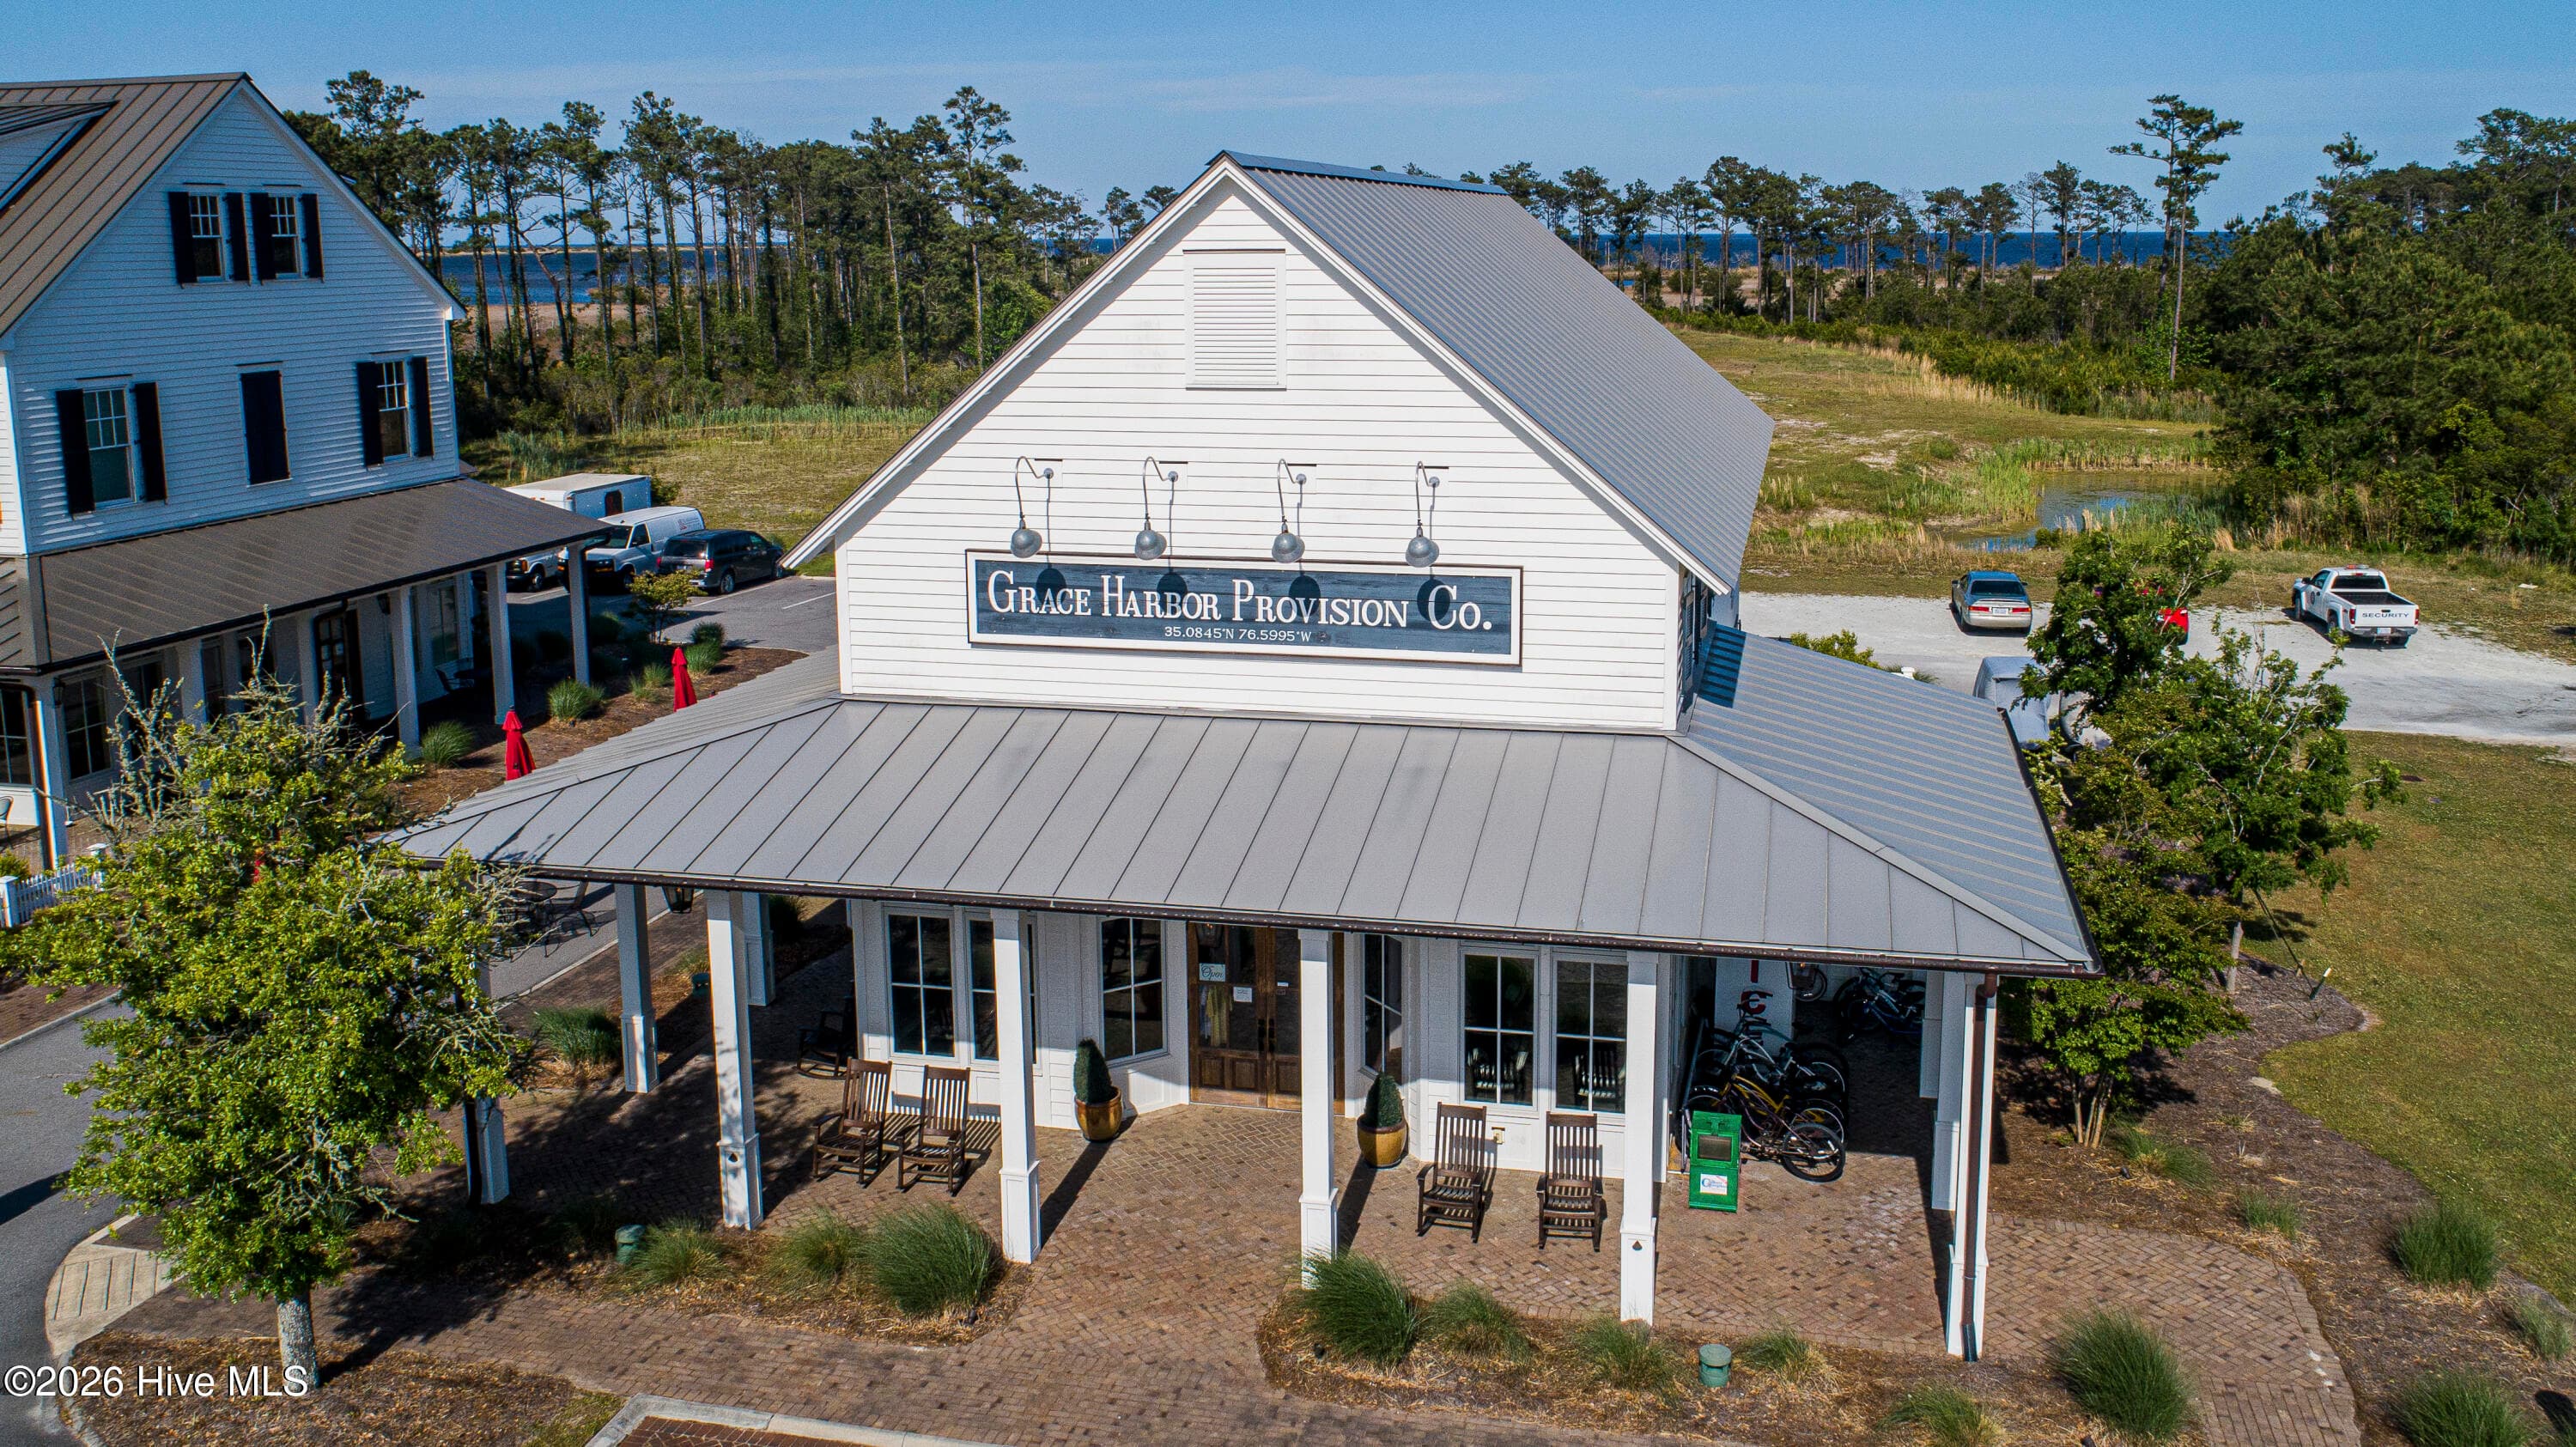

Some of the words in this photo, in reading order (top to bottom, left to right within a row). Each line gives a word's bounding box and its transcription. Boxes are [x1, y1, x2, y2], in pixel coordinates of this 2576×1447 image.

[988, 569, 1091, 616] GRACE
[1101, 575, 1222, 621] HARBOR
[1232, 579, 1409, 628] PROVISION
[1201, 965, 1224, 980] Open
